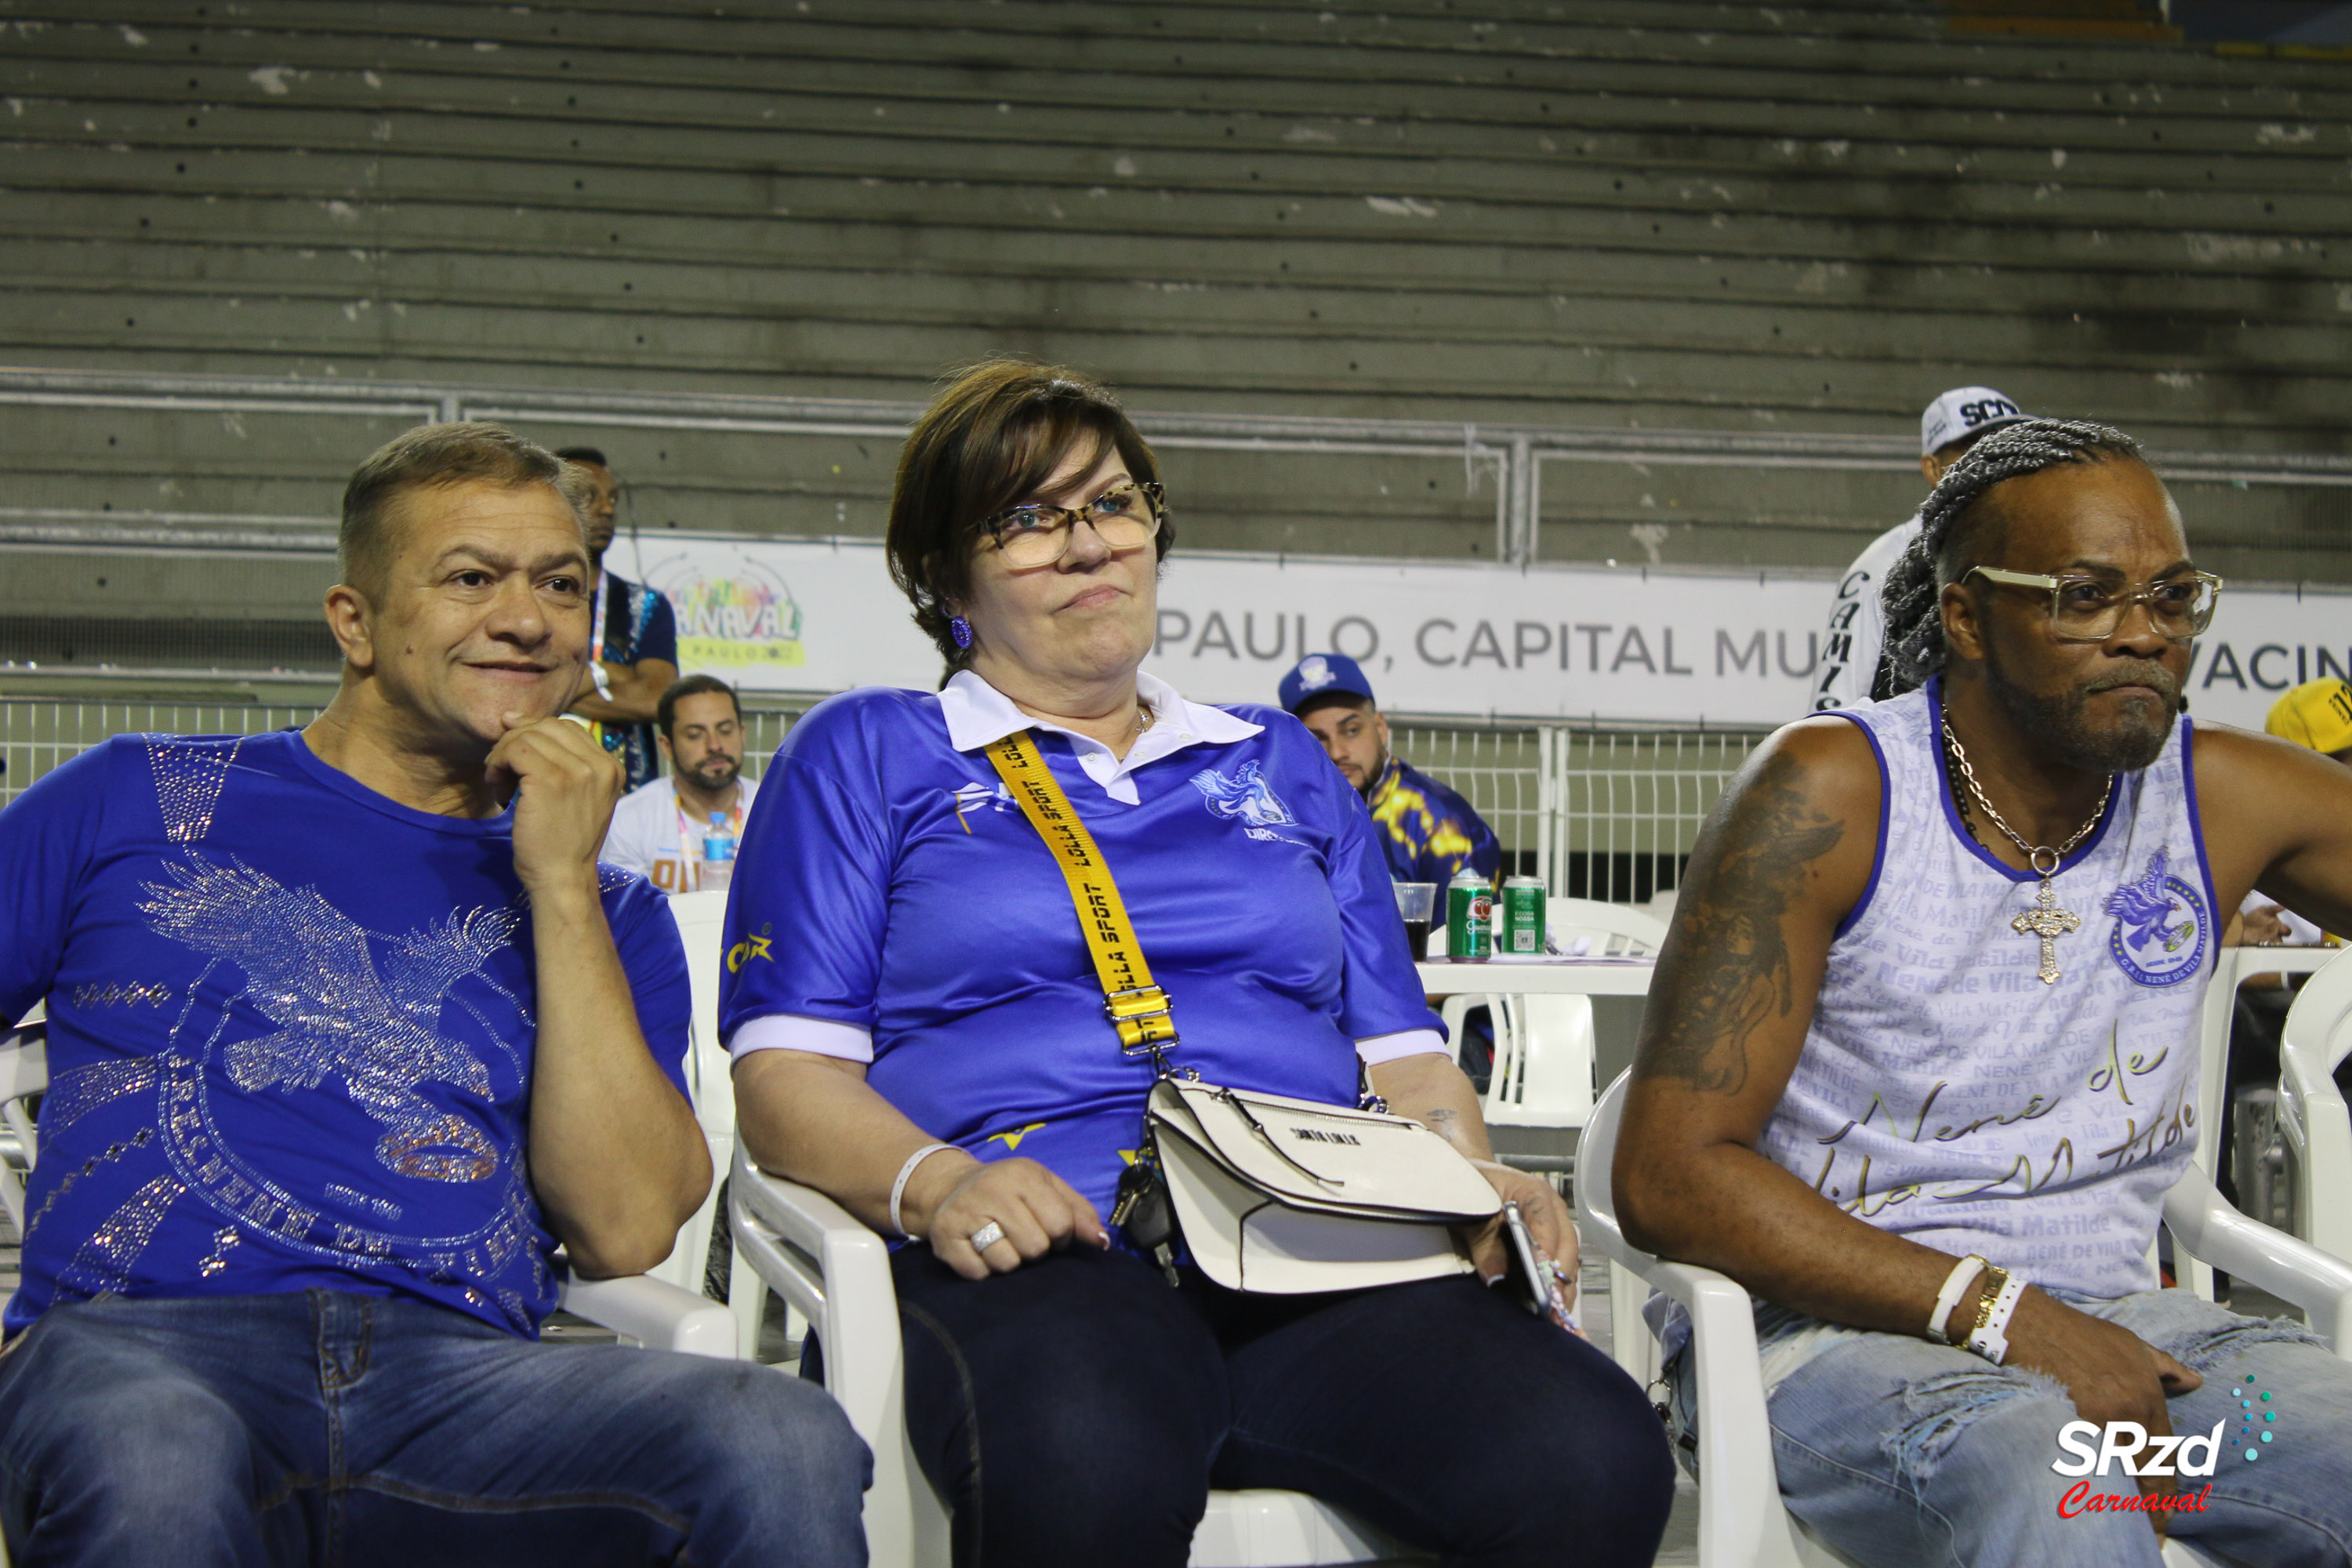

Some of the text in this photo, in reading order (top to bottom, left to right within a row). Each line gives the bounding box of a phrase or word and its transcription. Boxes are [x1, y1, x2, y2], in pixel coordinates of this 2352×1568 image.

[1415, 618, 1693, 676] CAPITAL
[1083, 882, 1120, 944] SPORT
[1988, 971, 2039, 994] Vila
[1973, 1042, 2017, 1060] VILA
[2086, 1018, 2169, 1106] de
[1973, 1061, 2034, 1079] NENÊ
[2021, 1214, 2111, 1237] Matilde
[2073, 1243, 2093, 1259] DE
